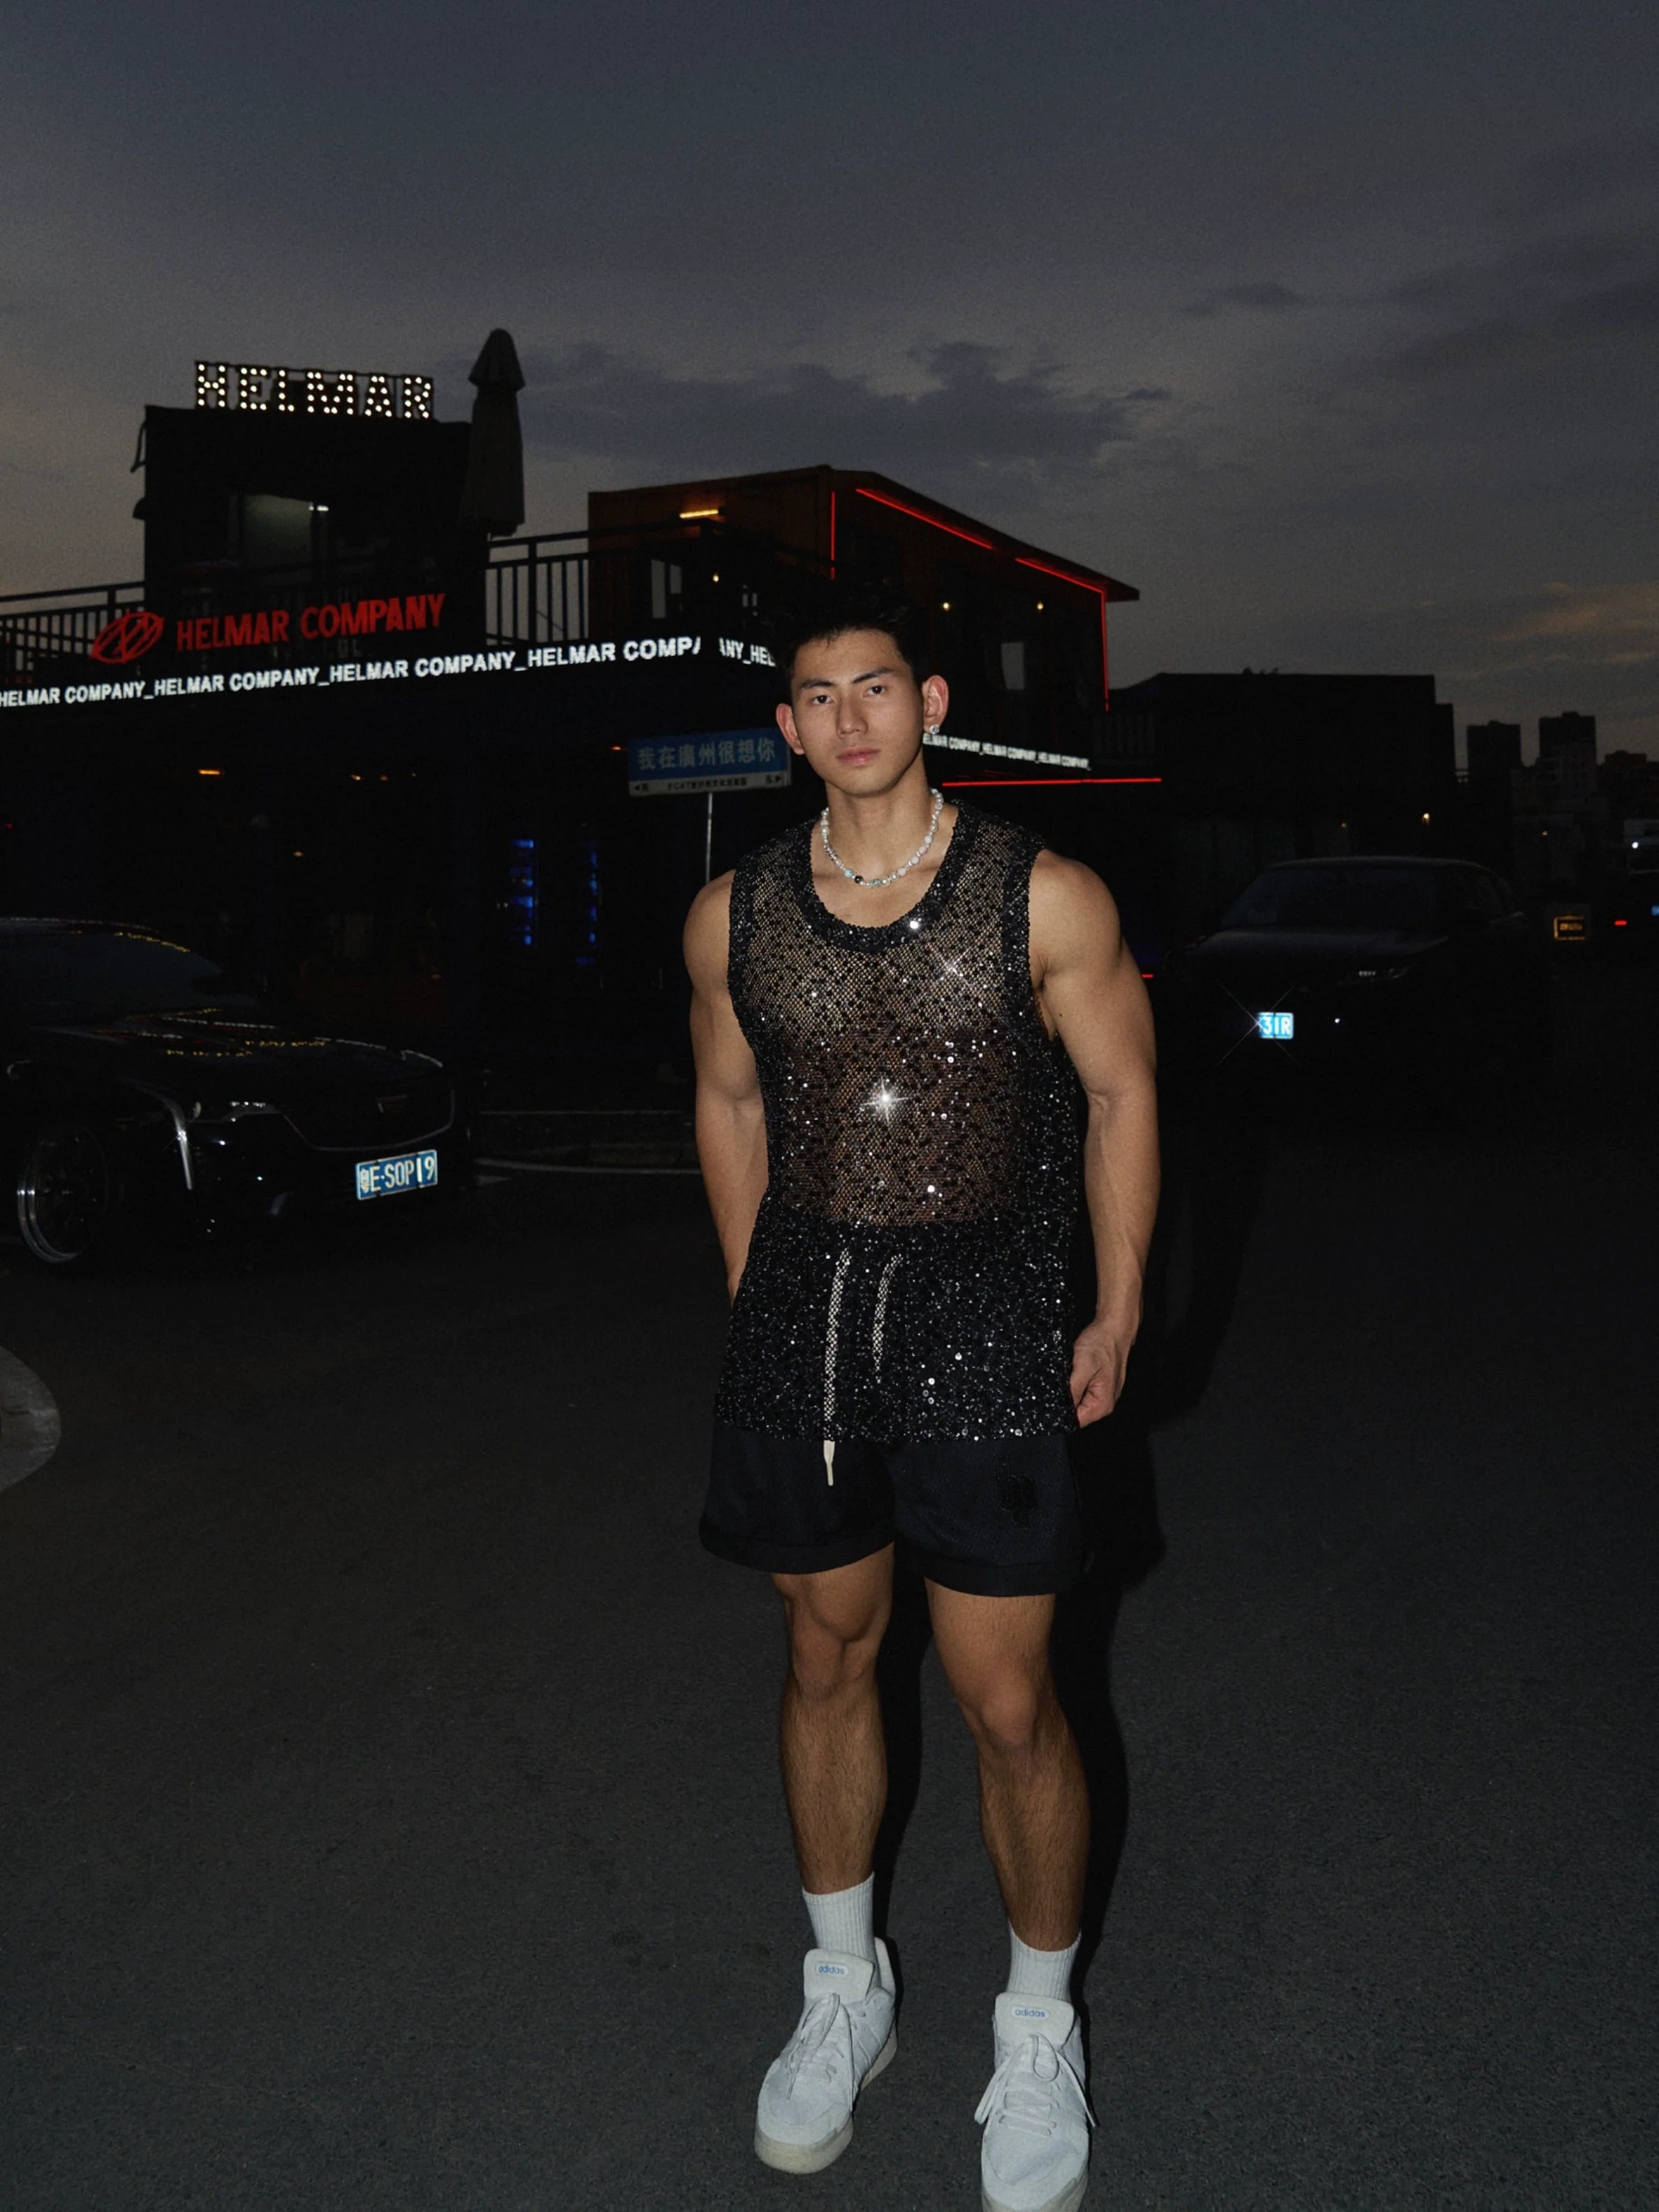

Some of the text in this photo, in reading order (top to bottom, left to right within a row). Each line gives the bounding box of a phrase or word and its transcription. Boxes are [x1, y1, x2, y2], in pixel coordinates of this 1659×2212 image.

[195, 362, 433, 419] HELMAR
[177, 593, 445, 651] HELMAR COMPANY
[637, 737, 776, 771] 我在廣州很想你
[1015, 2008, 1046, 2017] adidas
